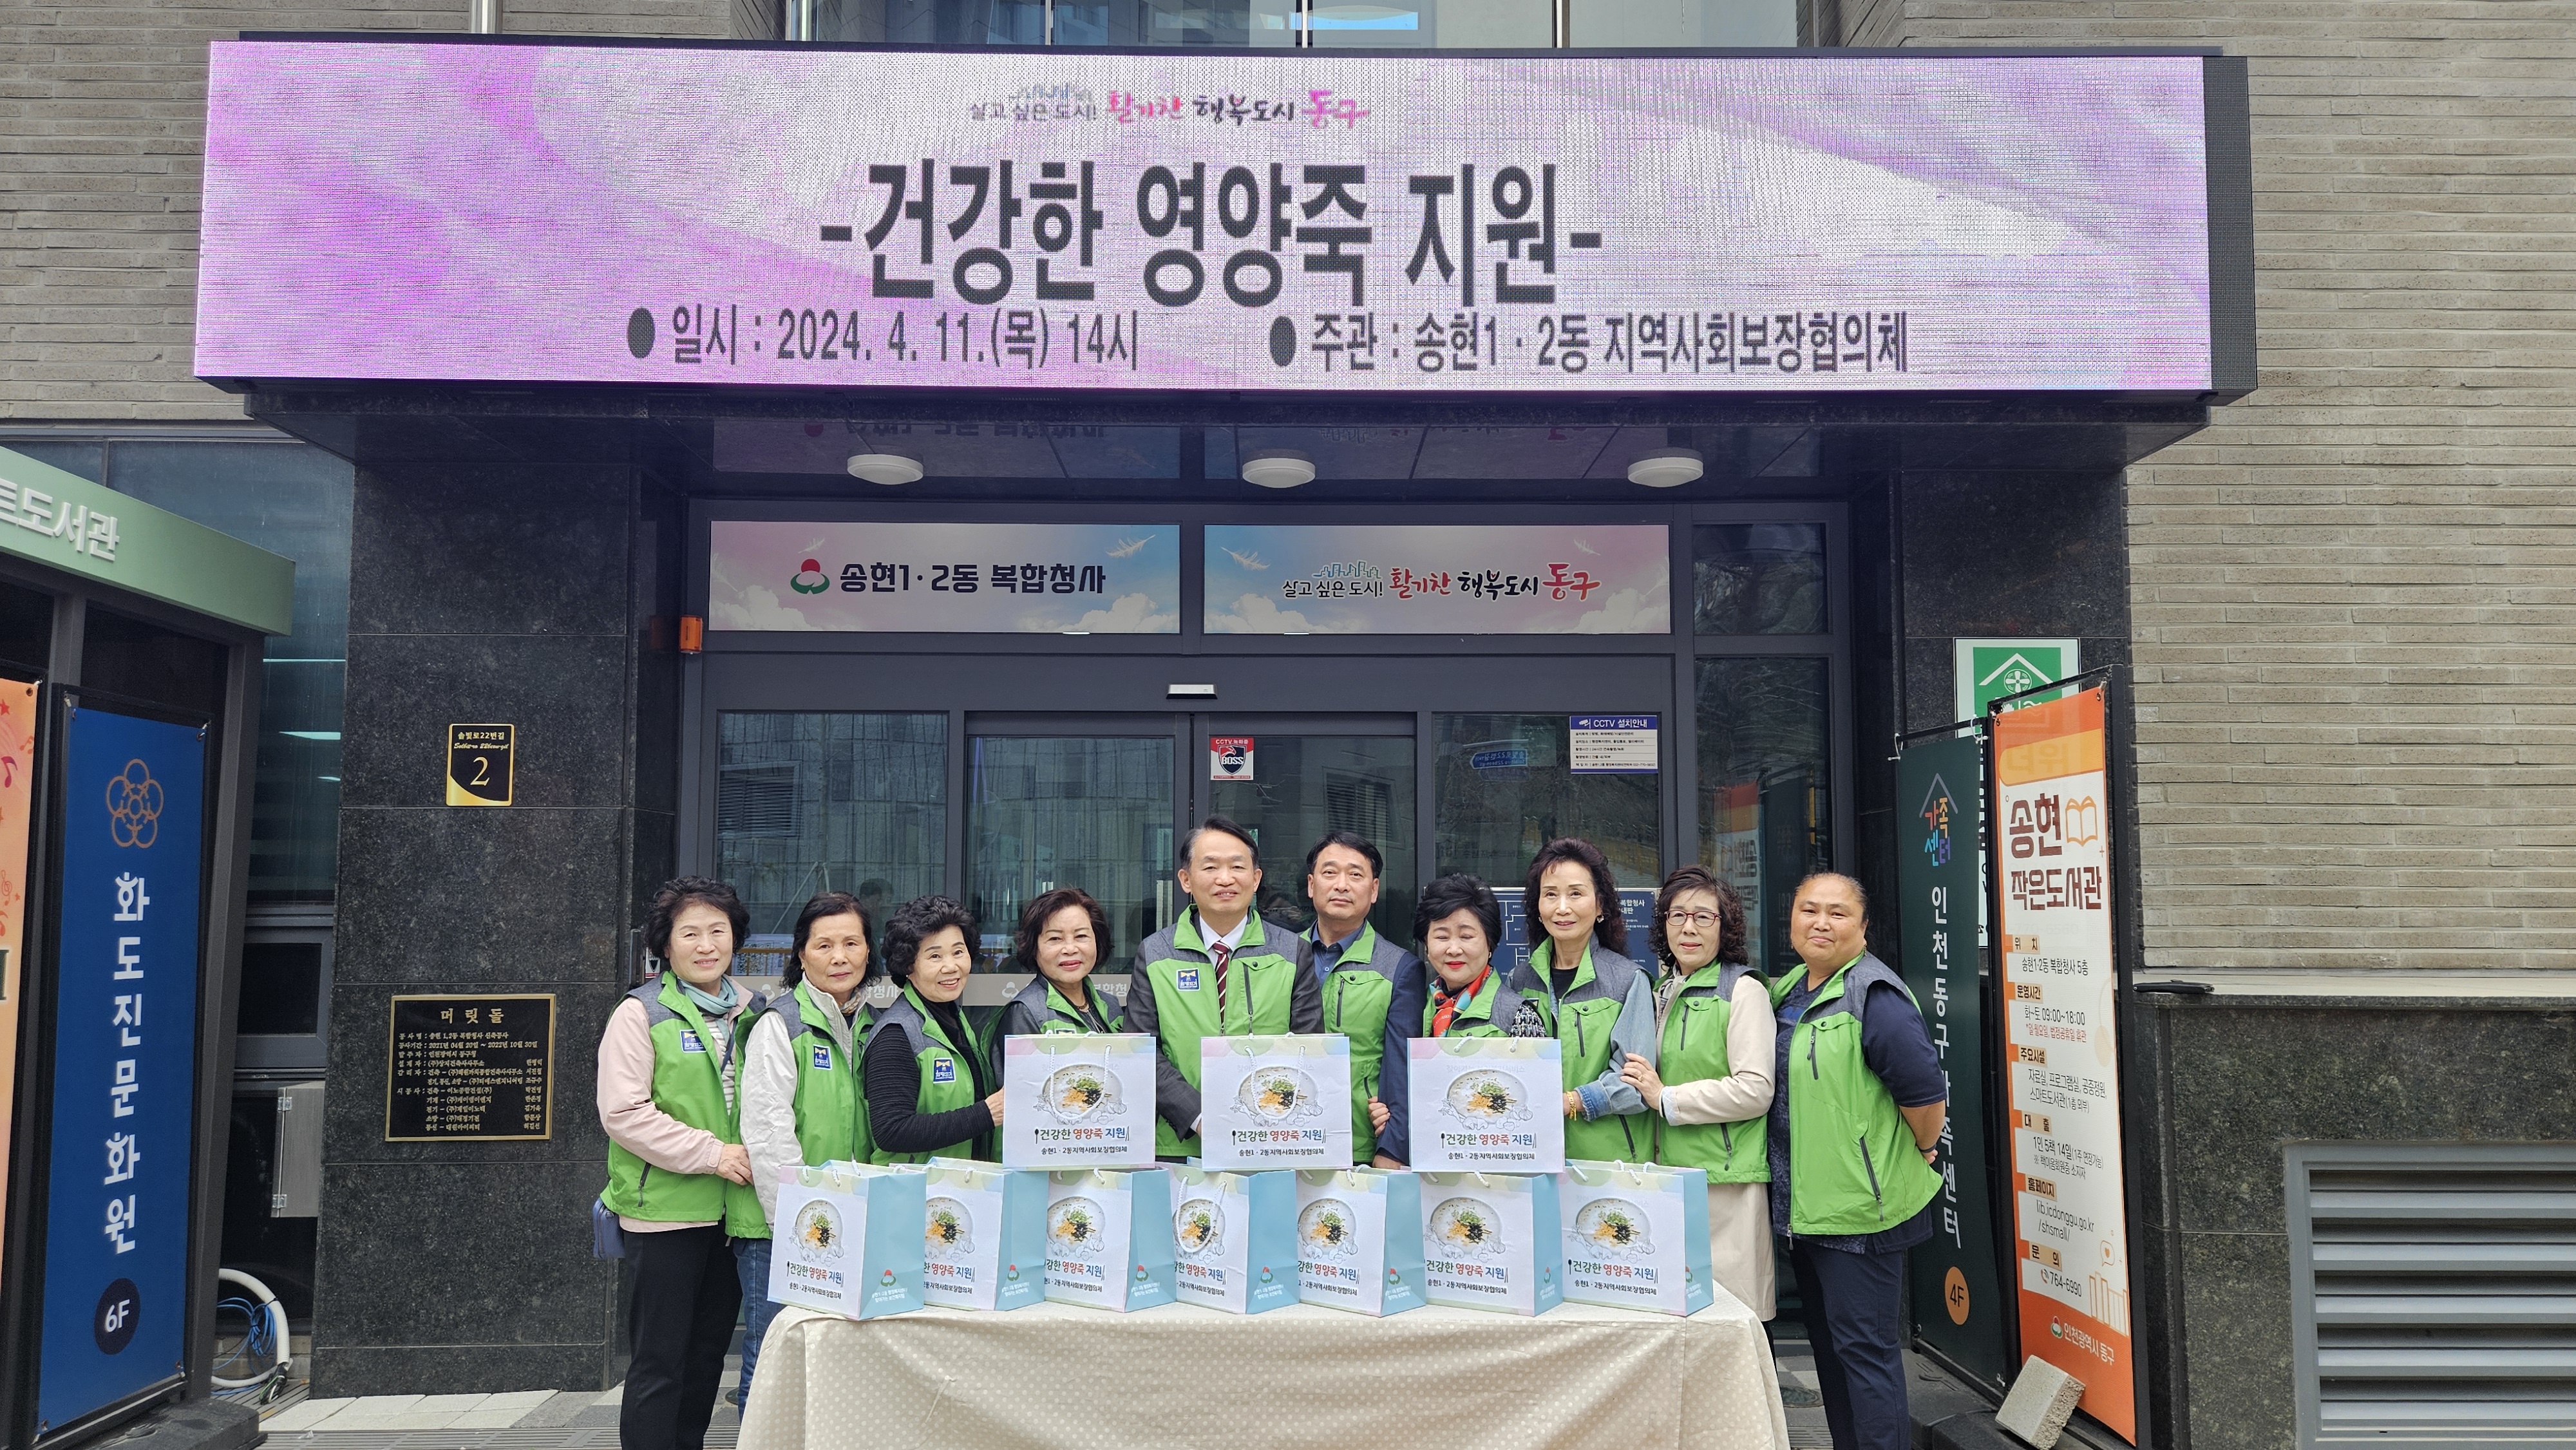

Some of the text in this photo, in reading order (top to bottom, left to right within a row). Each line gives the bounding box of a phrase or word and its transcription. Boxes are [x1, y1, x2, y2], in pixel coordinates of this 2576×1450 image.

[1013, 102, 1049, 121] 싶은
[1108, 89, 1185, 124] 활기찬
[1193, 94, 1295, 126] 행복도시
[1300, 88, 1370, 129] 동구
[1136, 161, 1372, 308] 영양죽
[672, 303, 737, 366] 일시
[777, 308, 873, 361] 2024.
[1068, 309, 1139, 371] 14시
[1311, 312, 1378, 372] 주관
[1604, 310, 1908, 373] 지역사회보장협의체
[990, 563, 1106, 594] 복합청사
[1283, 563, 1600, 601] 살고 싶은 도시! 활기찬 행복도시 동구
[1593, 719, 1647, 728] CCTV 설치안내
[469, 757, 490, 786] 2
[1221, 757, 1244, 765] BOSS
[2009, 793, 2063, 860] 송현
[2011, 865, 2103, 912] 작은도서관
[2050, 958, 2076, 975] 복합청사
[2077, 959, 2088, 976] 5층
[2016, 984, 2041, 1000] 운영시간
[2042, 1008, 2085, 1026] 09:00~18:00
[2050, 1026, 2075, 1042] 법정공휴일
[2076, 1029, 2087, 1043] 휴관
[104, 871, 150, 1255] 화도진문화원
[2020, 1047, 2045, 1064] 주요시설
[2029, 1068, 2049, 1087] 자료실,
[2049, 1072, 2082, 1095] 프로그램실,
[1039, 1127, 1126, 1141] 건강한 영양죽 지원
[1237, 1129, 1323, 1143] 건강한 영양죽 지원
[1446, 1133, 1533, 1146] 건강한 영양죽 지원
[2033, 1136, 2043, 1153] 1인
[2045, 1138, 2056, 1156] 5책
[2071, 1163, 2086, 1180] 소지자
[2027, 1177, 2055, 1198] 홈페이지
[2036, 1199, 2095, 1233] lib.icdonggu.go.kr
[790, 1263, 842, 1285] 건강한 영양죽 지원
[931, 1262, 955, 1277] 영양죽
[956, 1266, 972, 1280] 지원
[1062, 1261, 1085, 1276] 영양죽
[1086, 1264, 1103, 1278] 지원
[1186, 1263, 1208, 1278] 영양죽
[1208, 1268, 1224, 1282] 지원
[1314, 1263, 1338, 1278] 영양죽
[1339, 1267, 1356, 1281] 지원
[1426, 1259, 1505, 1280] 건강한 영양죽 지원
[1573, 1260, 1654, 1281] 건강한 영양죽 지원
[2049, 1271, 2082, 1297] 764-6990
[1949, 1283, 1964, 1308] 4F
[104, 1298, 130, 1335] 6F
[2063, 1323, 2115, 1366] 인천광역시 동구
